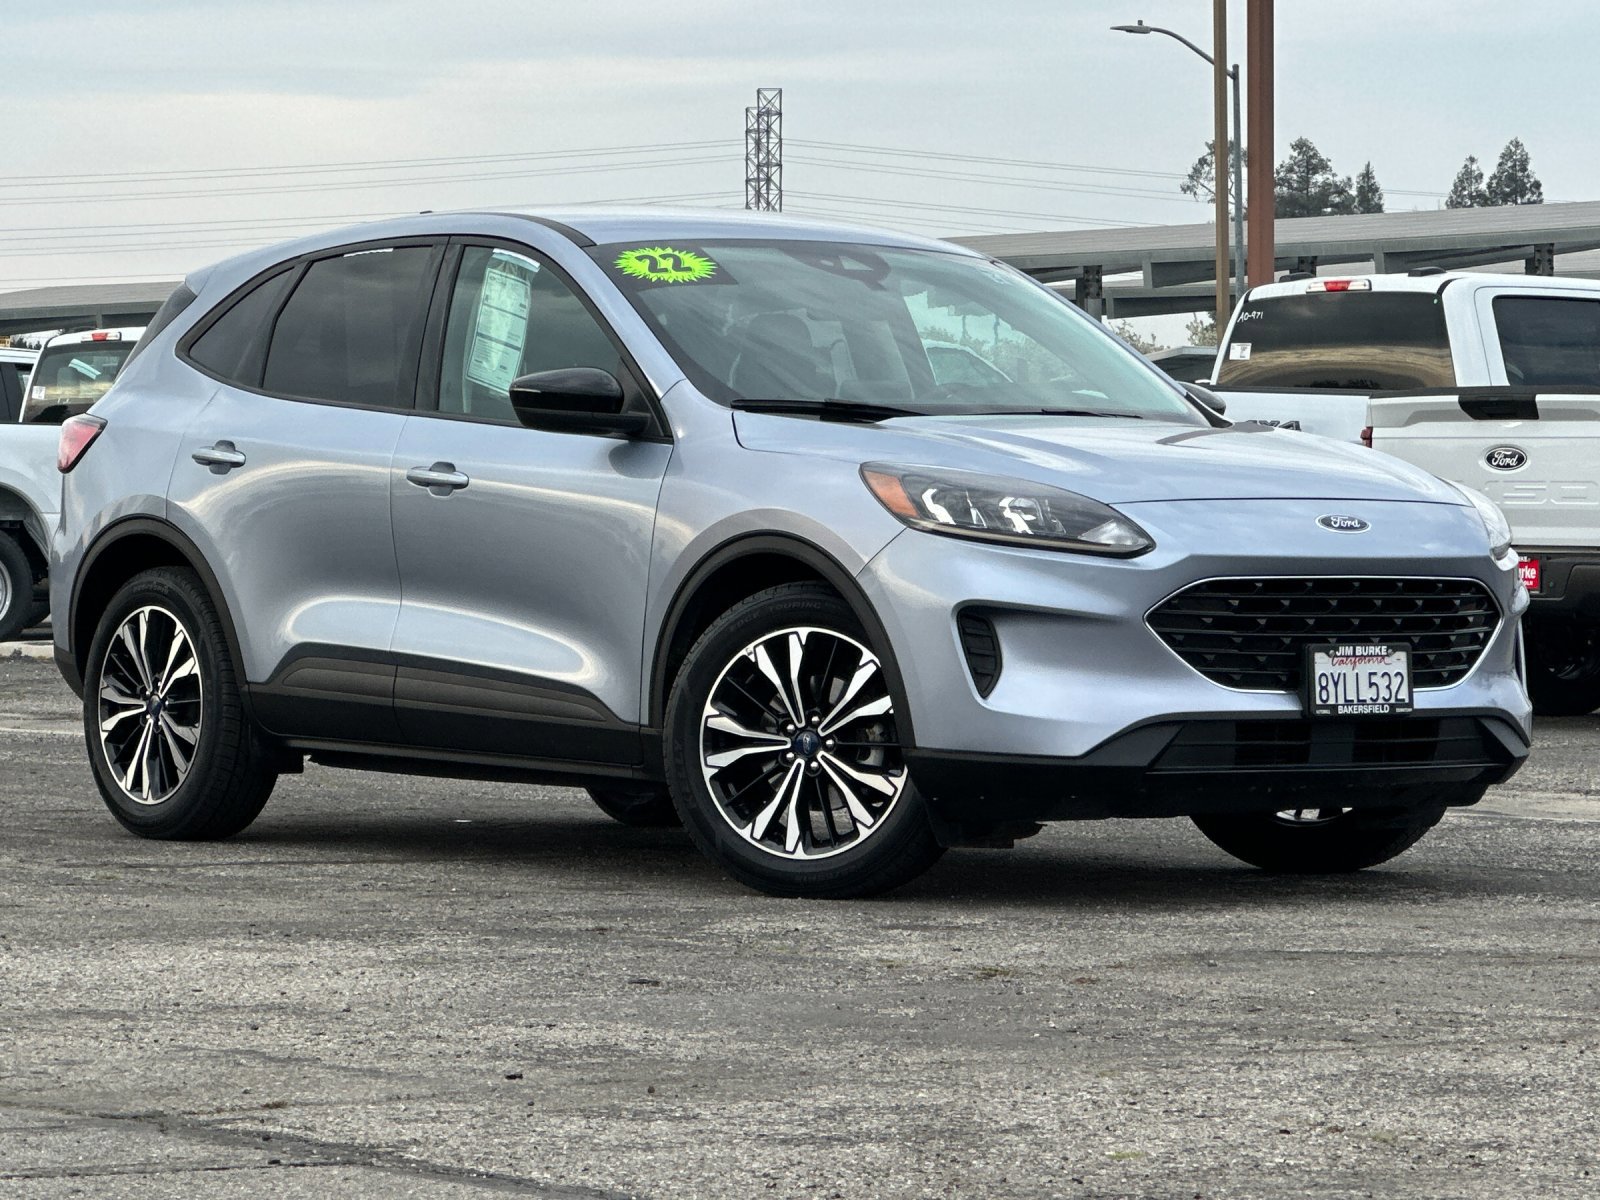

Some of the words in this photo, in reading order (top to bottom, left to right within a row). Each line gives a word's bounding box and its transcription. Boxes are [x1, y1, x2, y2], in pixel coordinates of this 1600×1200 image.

[1492, 451, 1518, 466] Ford
[1331, 516, 1360, 527] Ford
[1336, 646, 1353, 656] JIM
[1355, 646, 1388, 656] BURKE
[1318, 671, 1406, 704] 8YLL532
[1337, 704, 1390, 715] BAKERSFIELD
